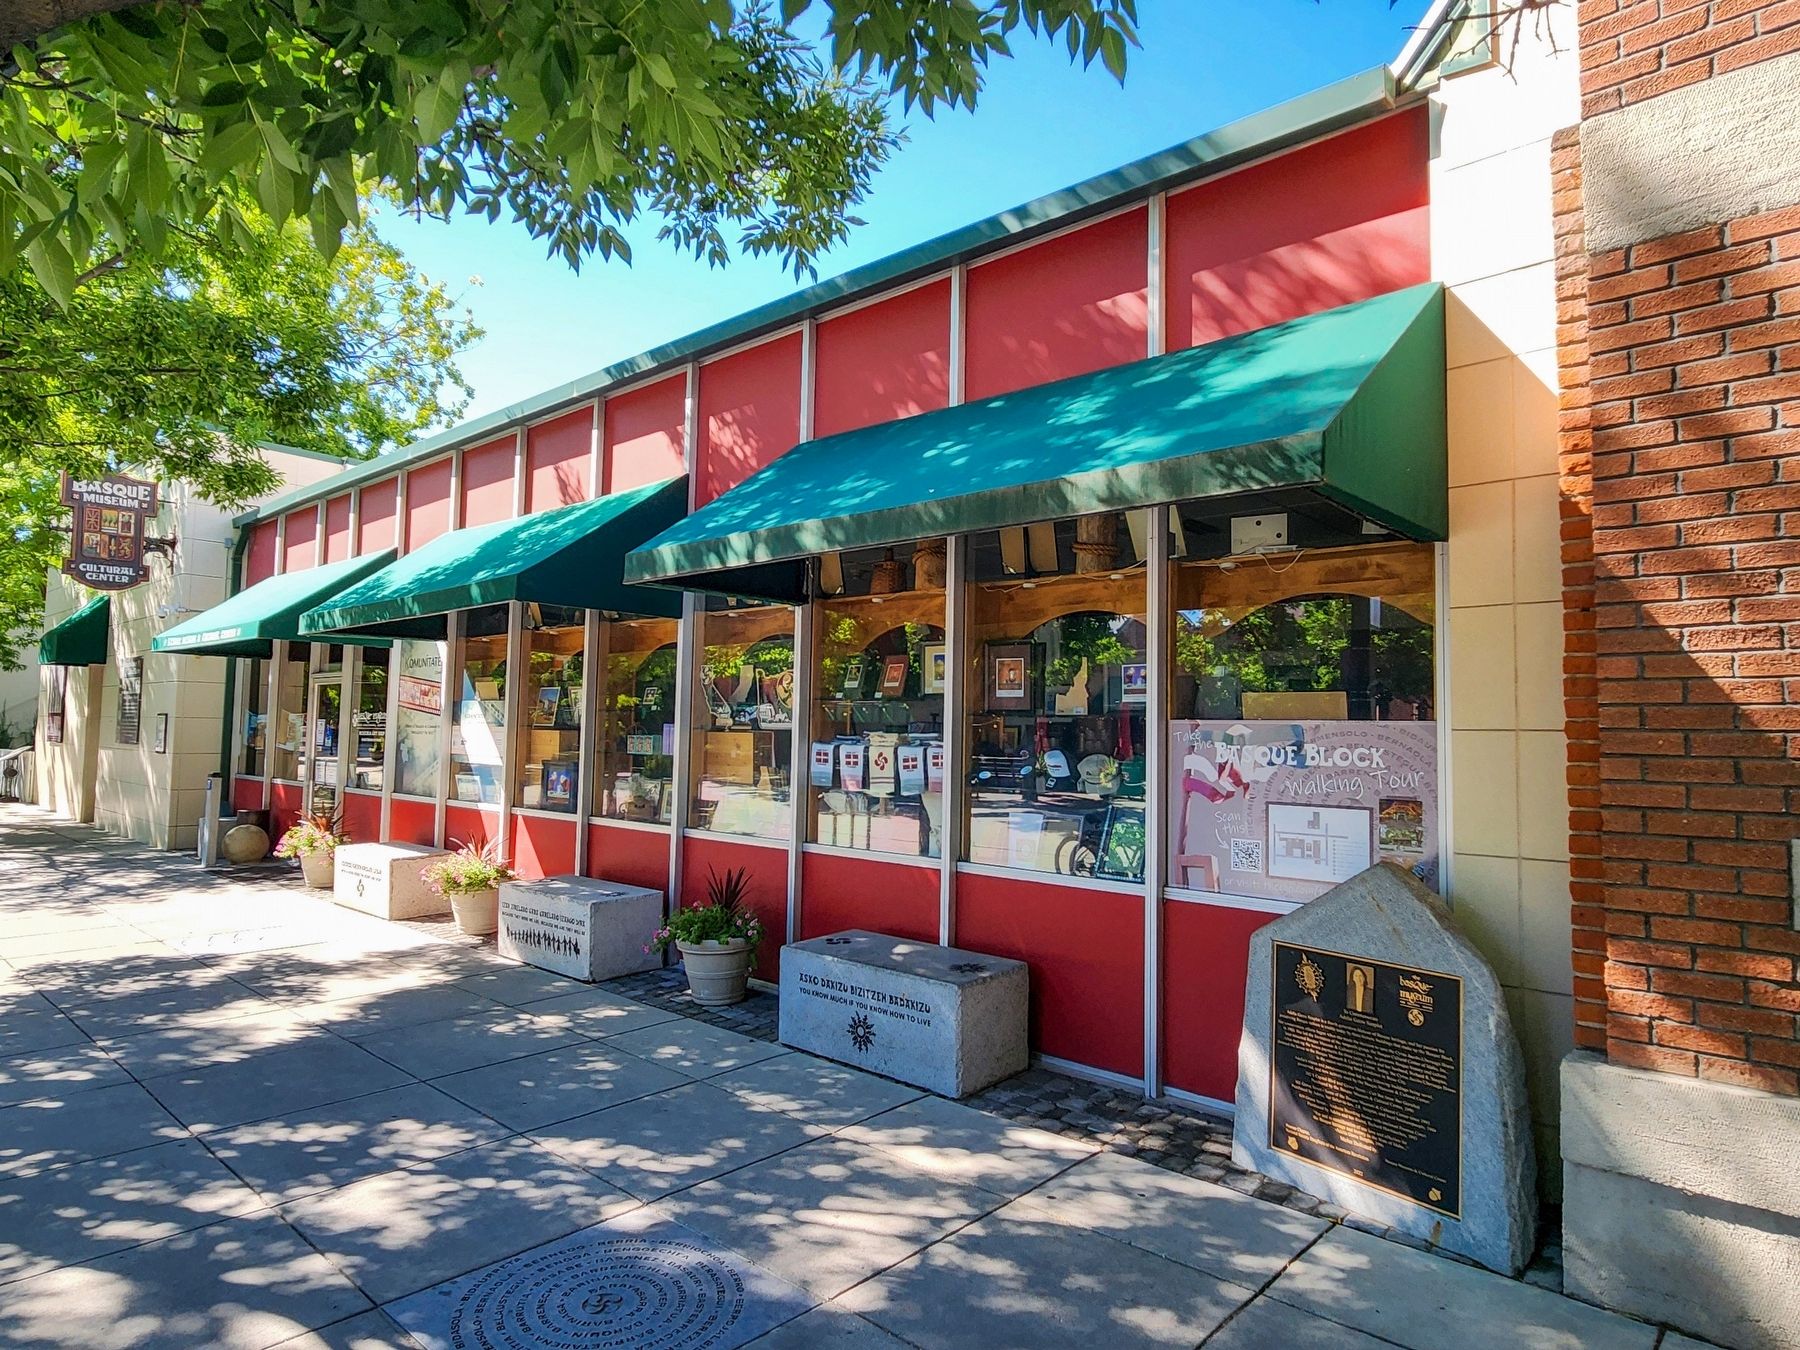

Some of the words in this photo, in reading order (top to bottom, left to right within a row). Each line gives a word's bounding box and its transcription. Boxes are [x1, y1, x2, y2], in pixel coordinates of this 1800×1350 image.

[72, 480, 150, 500] BASQUE
[83, 492, 139, 508] MUSEUM
[79, 563, 136, 576] CULTURAL
[85, 572, 129, 583] CENTER
[1173, 729, 1201, 741] Take
[1193, 740, 1213, 752] the
[1215, 741, 1298, 768] BASQUE
[1304, 743, 1386, 768] BLOCK
[1284, 774, 1364, 799] Walking
[1369, 769, 1425, 789] Tour
[1215, 810, 1241, 823] Scan
[799, 972, 819, 986] ASKO
[820, 978, 849, 993] DAKIZU
[850, 985, 888, 1003] BIZITZEN
[888, 994, 931, 1014] BADAKIZU
[799, 987, 811, 995] YOU
[812, 989, 829, 1000] KNOW
[830, 994, 848, 1006] MUCH
[856, 1001, 868, 1011] YOU
[869, 1006, 888, 1016] KNOW
[890, 1010, 905, 1020] HOW
[906, 1014, 916, 1022] TO
[916, 1016, 932, 1028] LIVE
